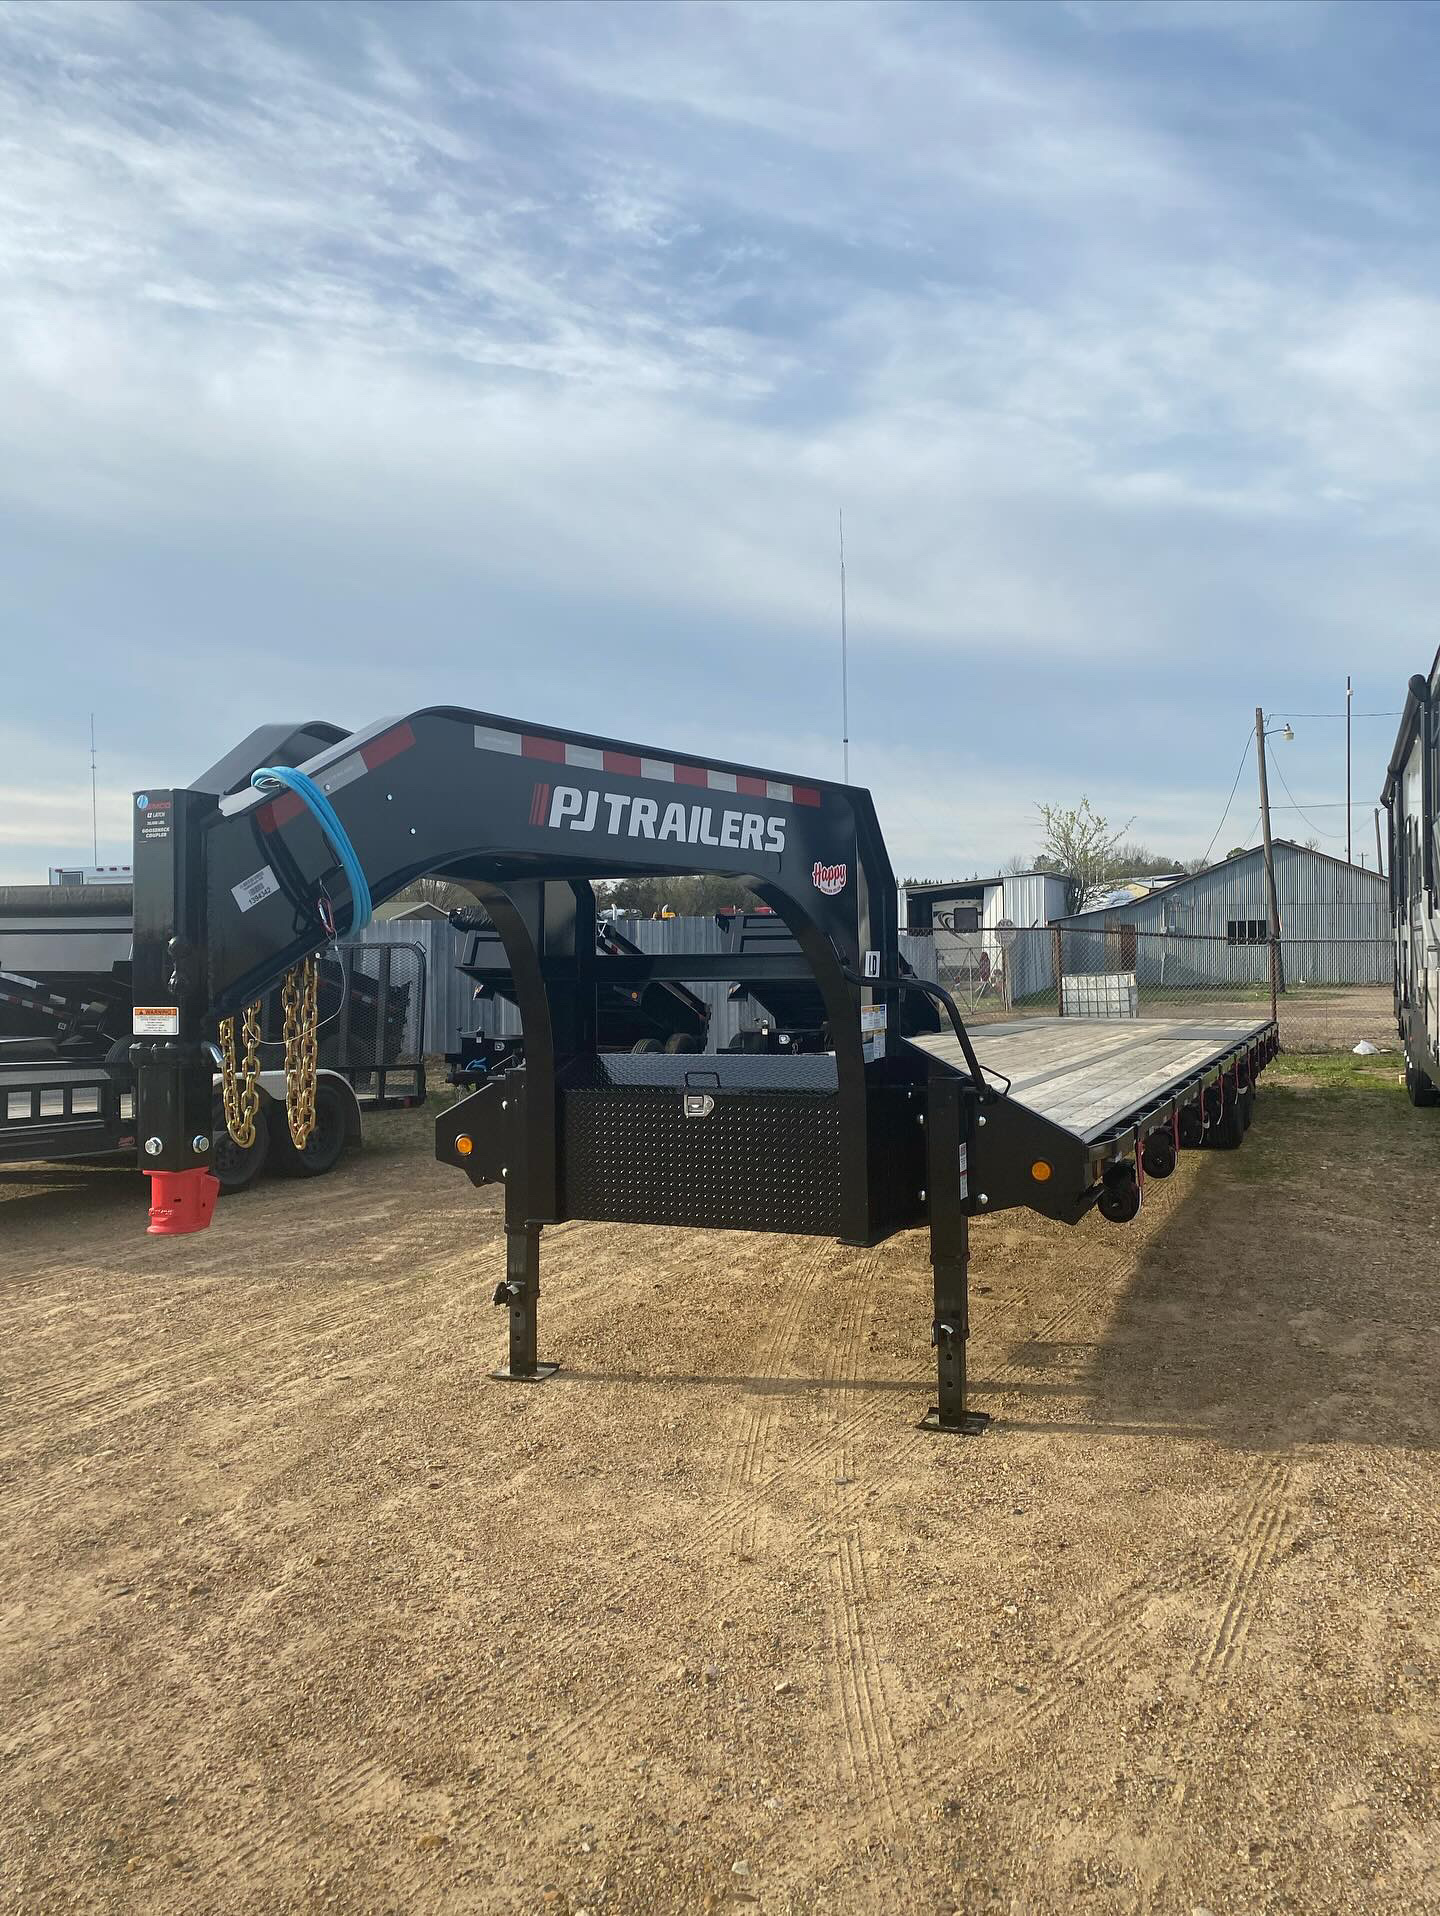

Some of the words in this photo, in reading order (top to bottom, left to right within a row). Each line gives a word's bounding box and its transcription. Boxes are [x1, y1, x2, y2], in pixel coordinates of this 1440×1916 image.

[549, 786, 599, 832] PJ
[604, 793, 786, 853] TRAILERS
[813, 862, 846, 888] Happy
